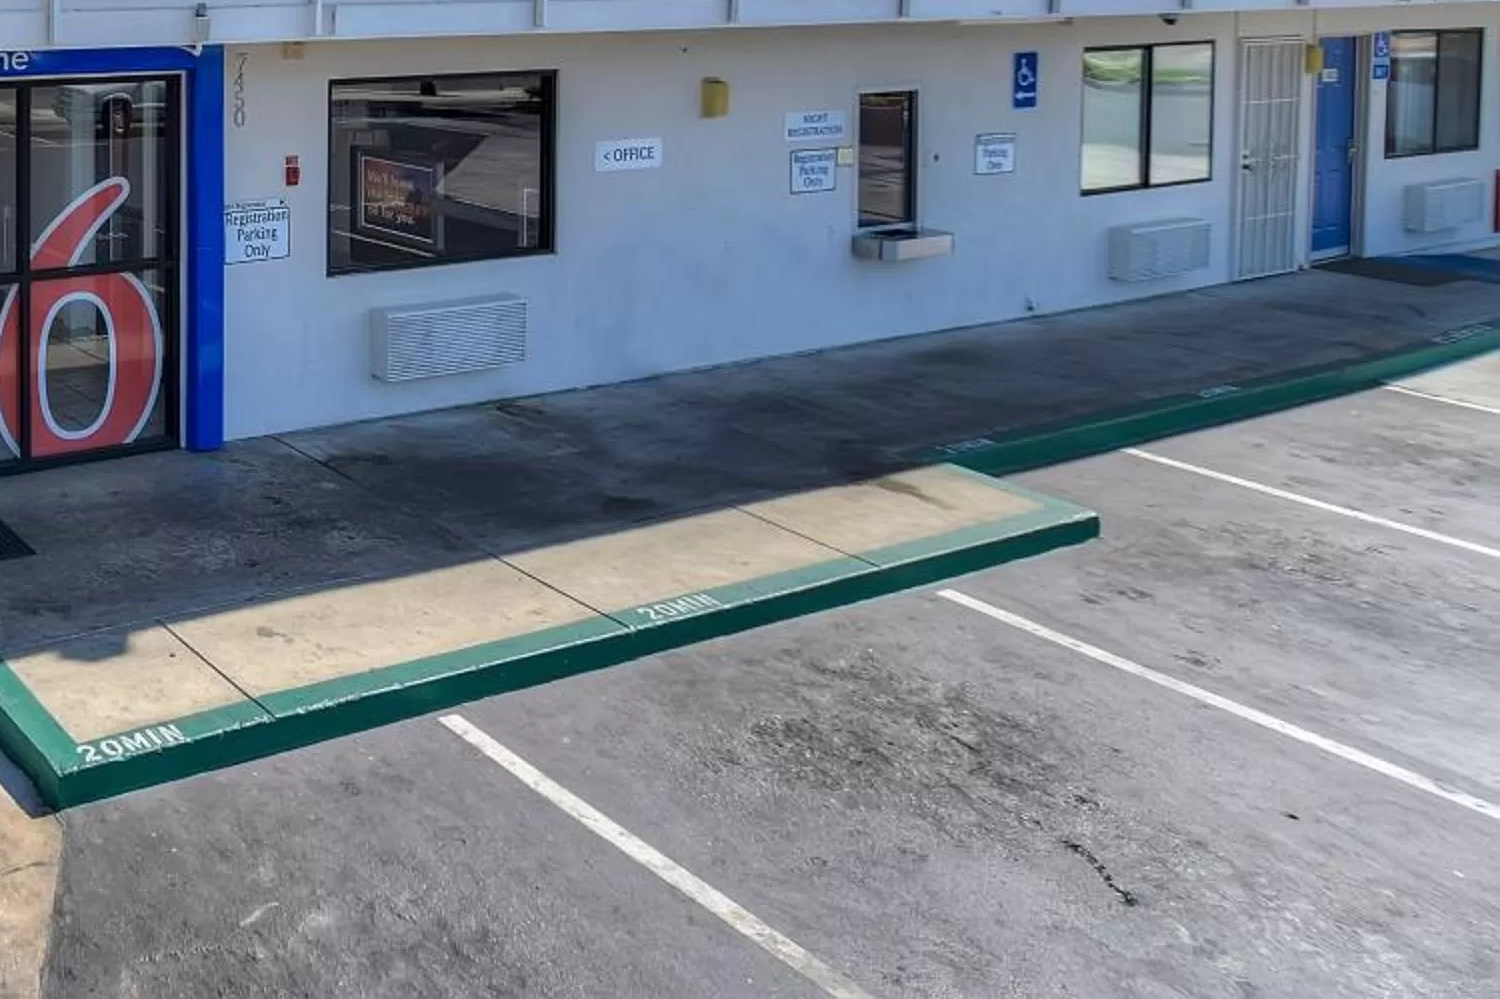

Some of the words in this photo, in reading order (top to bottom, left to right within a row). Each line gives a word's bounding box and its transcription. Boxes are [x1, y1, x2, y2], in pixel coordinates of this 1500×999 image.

[613, 146, 655, 162] OFFICE
[225, 210, 288, 228] Registration
[237, 227, 278, 242] Parking
[245, 244, 271, 258] Only
[76, 724, 187, 763] 20MIN
